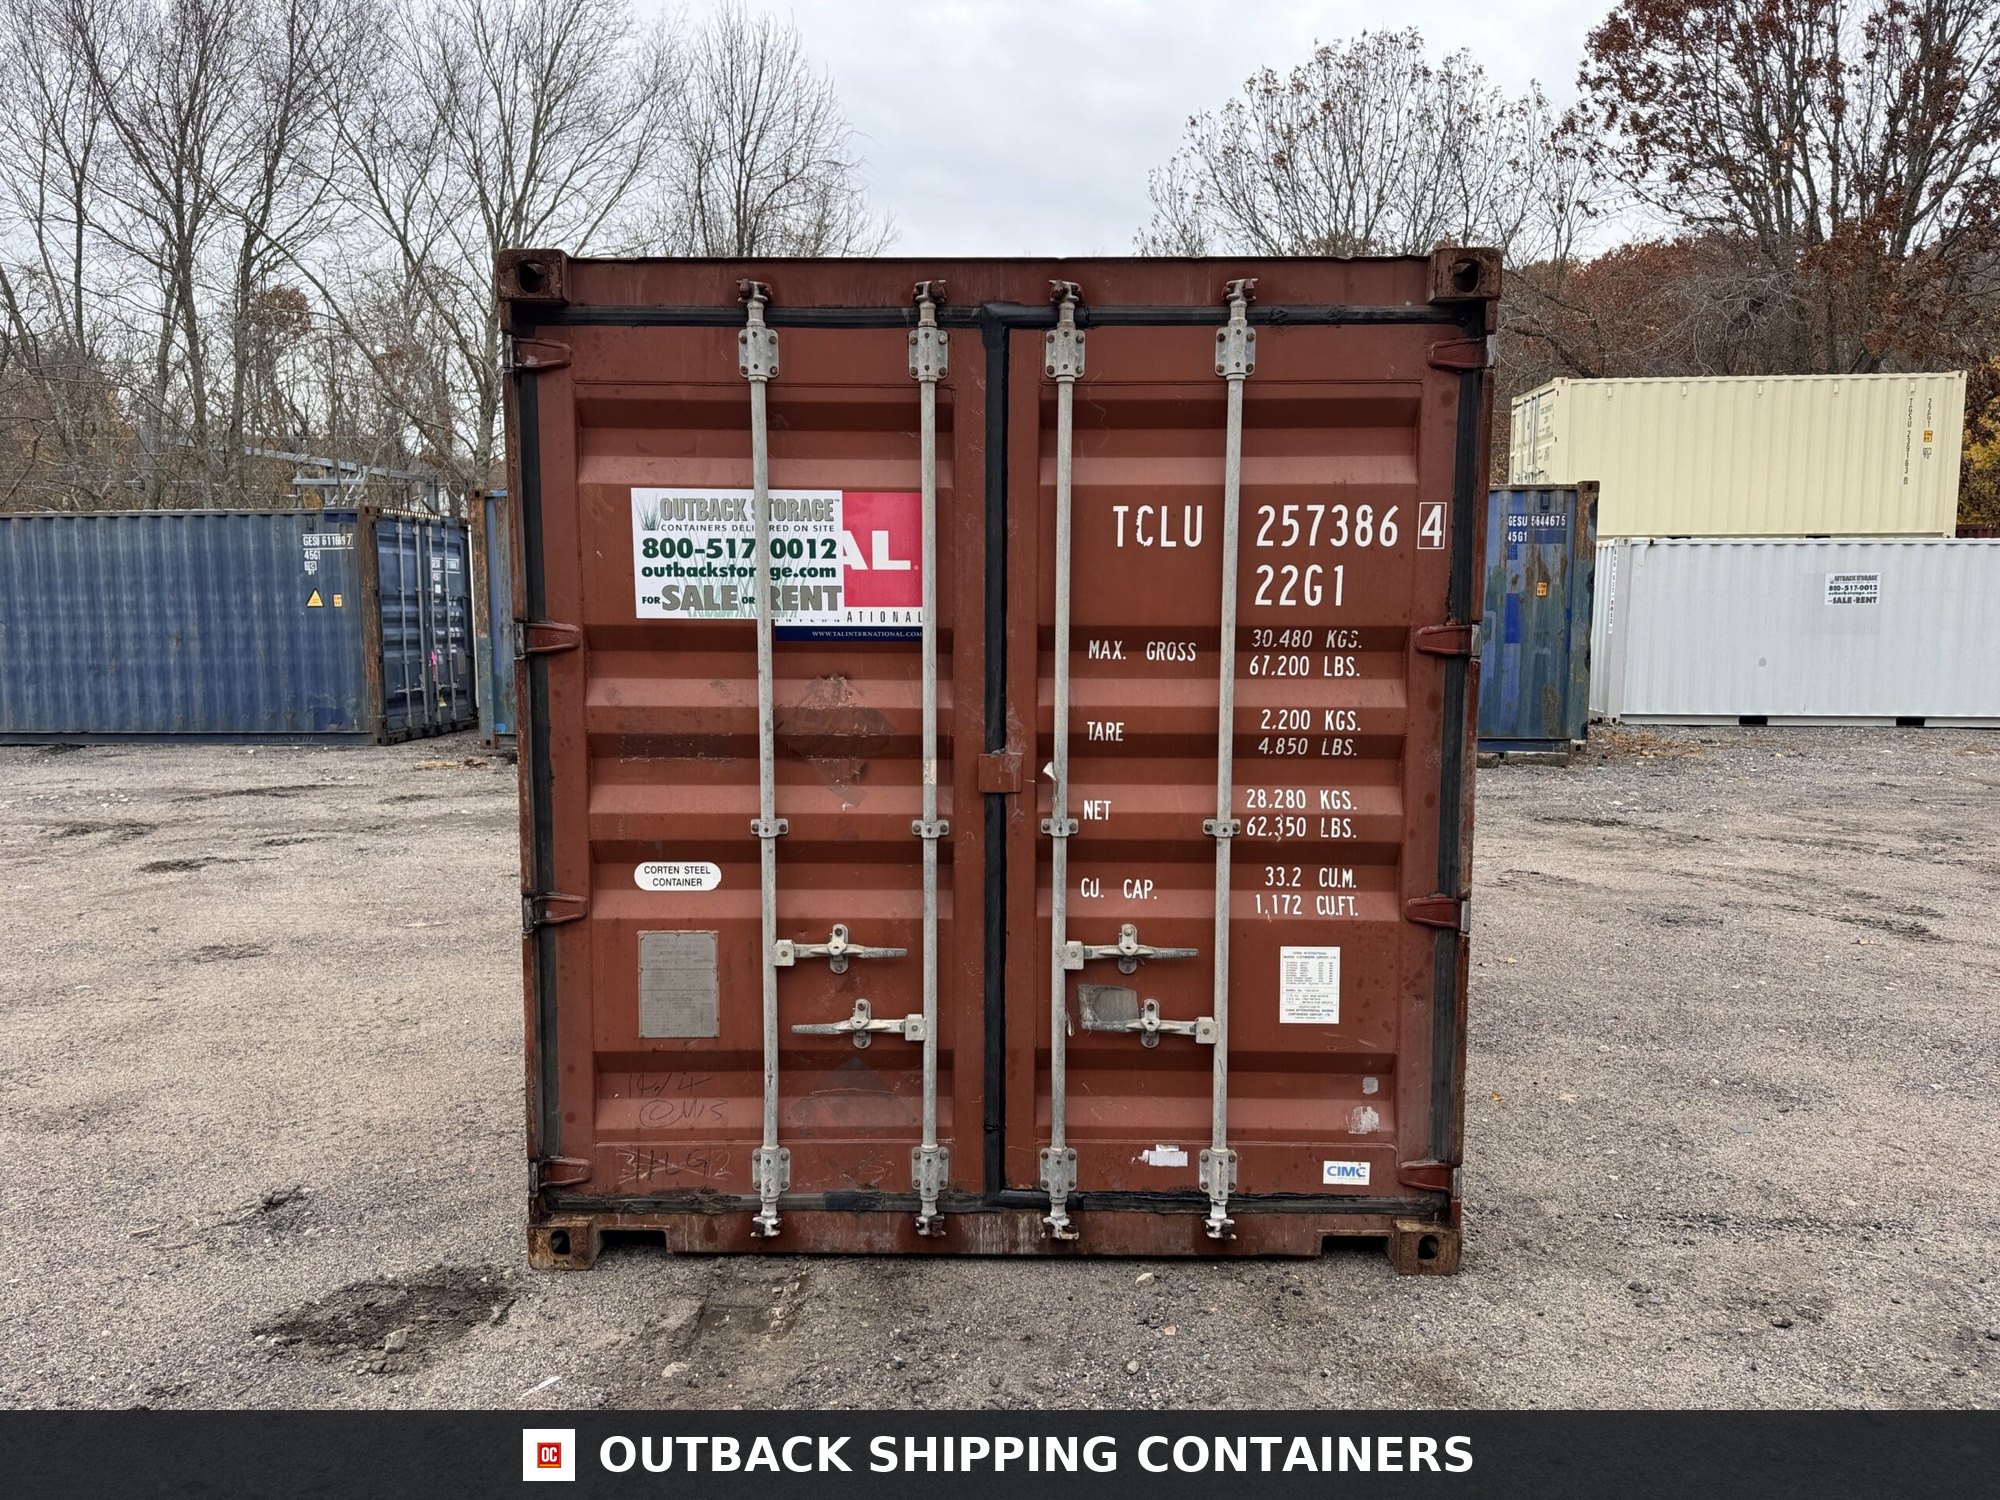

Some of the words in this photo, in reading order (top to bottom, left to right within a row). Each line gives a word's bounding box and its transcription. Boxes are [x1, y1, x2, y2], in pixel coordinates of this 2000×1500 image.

[660, 498, 746, 521] OUTBACK
[661, 524, 727, 532] CONTAINERS
[732, 524, 789, 532] DELIRED
[1113, 505, 1203, 547] TCLU
[1256, 505, 1399, 547] 257386
[1421, 505, 1443, 547] 4
[1508, 516, 1527, 527] GESU
[1508, 531, 1528, 542] 45G1
[642, 537, 837, 559] 800-5170012
[641, 561, 836, 580] outbackstorge.com
[1255, 565, 1343, 606] 22G1
[642, 597, 660, 605] FOR
[662, 585, 738, 611] SALE
[742, 597, 755, 605] OR
[1326, 630, 1362, 649] KGS.
[1088, 640, 1127, 660] MAX.
[1146, 641, 1196, 661] GROSS
[1249, 655, 1310, 676] 67,200
[1324, 656, 1360, 677] LBS.
[1261, 709, 1311, 730] 2,200
[1325, 710, 1361, 731] KGS.
[1087, 722, 1125, 742] TARE
[1258, 737, 1308, 755] 4,850
[1321, 738, 1357, 756] LBS.
[1246, 788, 1306, 809] 28,280
[1320, 790, 1357, 810] KGS.
[1083, 800, 1111, 820] NET
[1246, 816, 1306, 837] 62,350
[1320, 817, 1357, 838] LBS.
[644, 866, 680, 874] CORTEN
[684, 866, 711, 874] STEEL
[1265, 866, 1302, 887] 33.2
[1319, 867, 1357, 889] CU.M.
[652, 878, 703, 887] CONTAINER
[1081, 877, 1104, 898] CU.
[1123, 879, 1158, 900] CAP.
[1316, 895, 1359, 917] CU.FT.
[1327, 1166, 1367, 1177] CIMC
